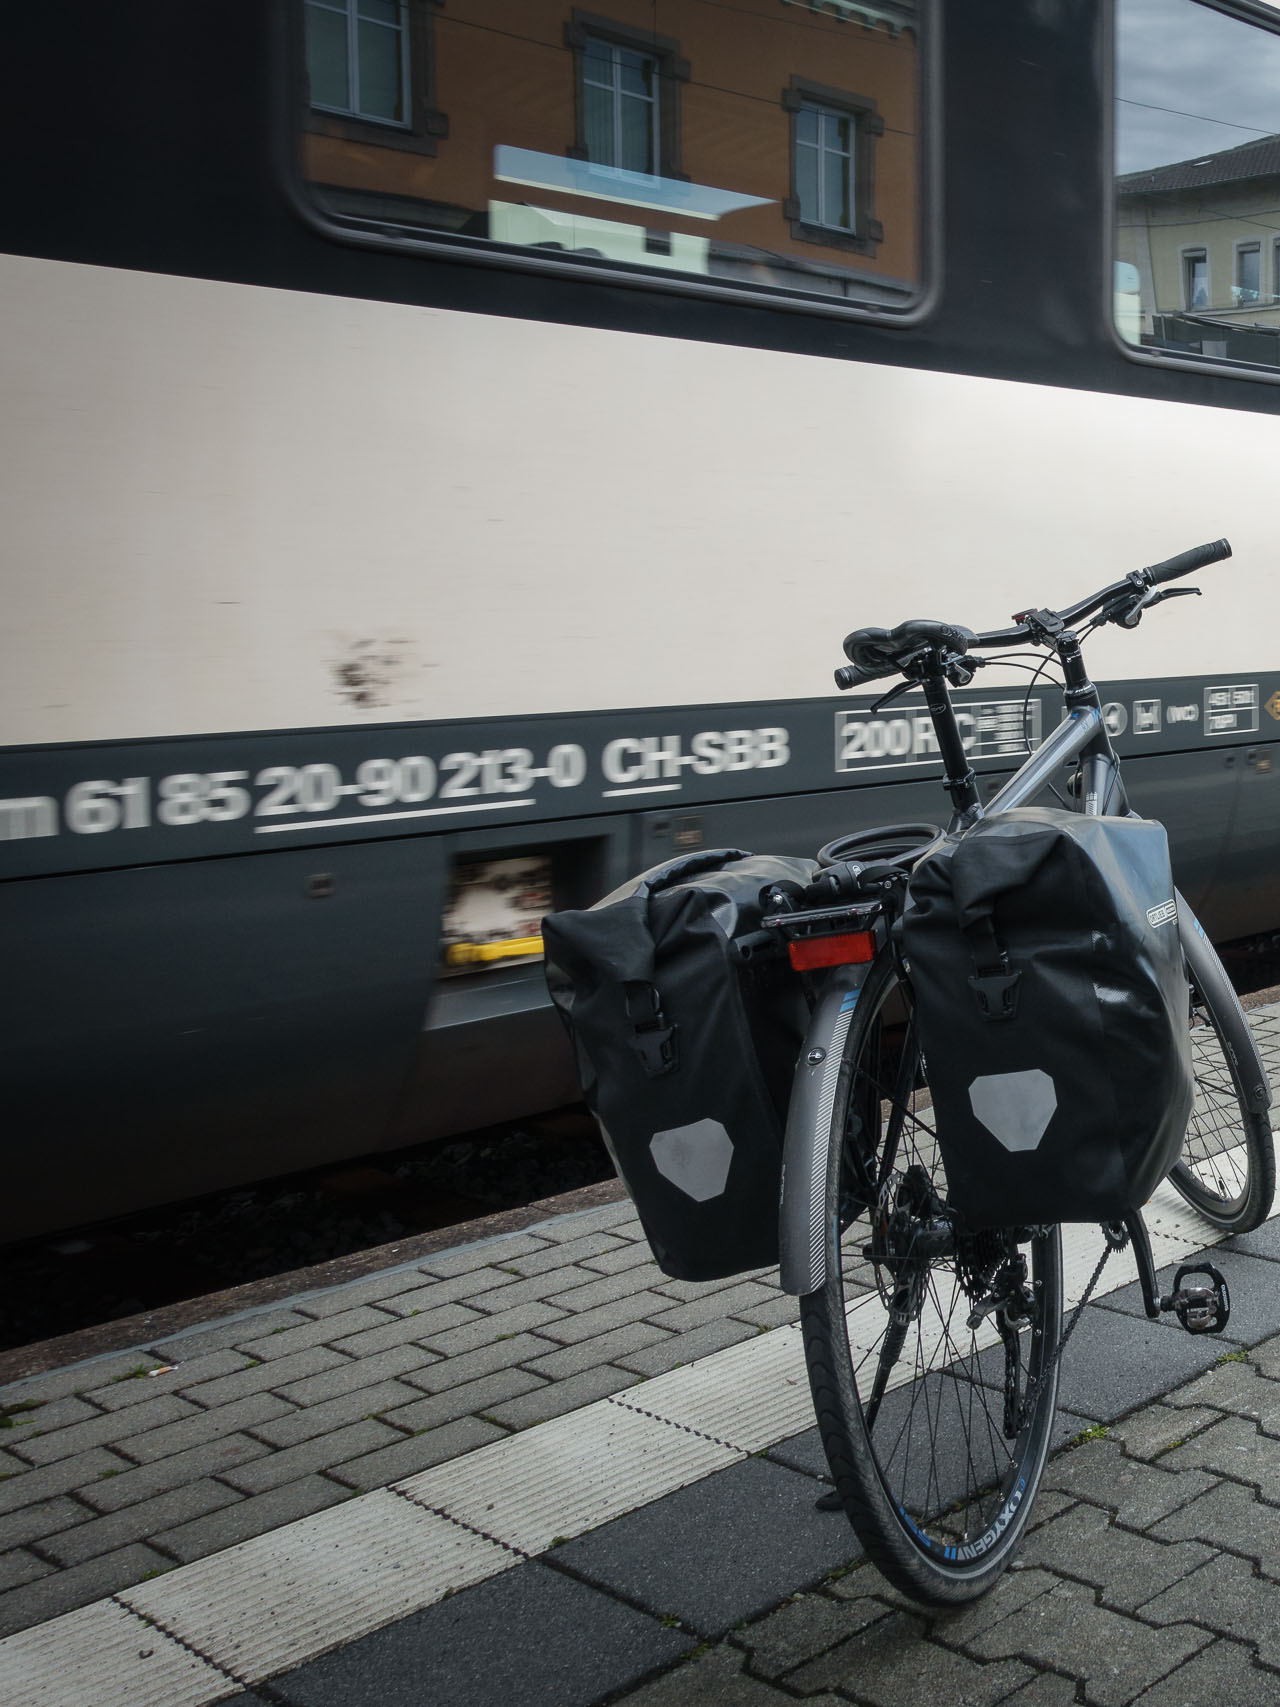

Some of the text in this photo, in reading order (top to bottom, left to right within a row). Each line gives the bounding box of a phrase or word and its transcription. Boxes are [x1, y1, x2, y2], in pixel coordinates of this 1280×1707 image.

[840, 718, 911, 760] 200
[65, 776, 152, 835] 61
[158, 770, 252, 826] 85
[254, 755, 437, 817] 20-90
[440, 743, 588, 798] 213-0
[601, 726, 791, 784] CH-SBB
[963, 1491, 1022, 1560] OXYGEN
